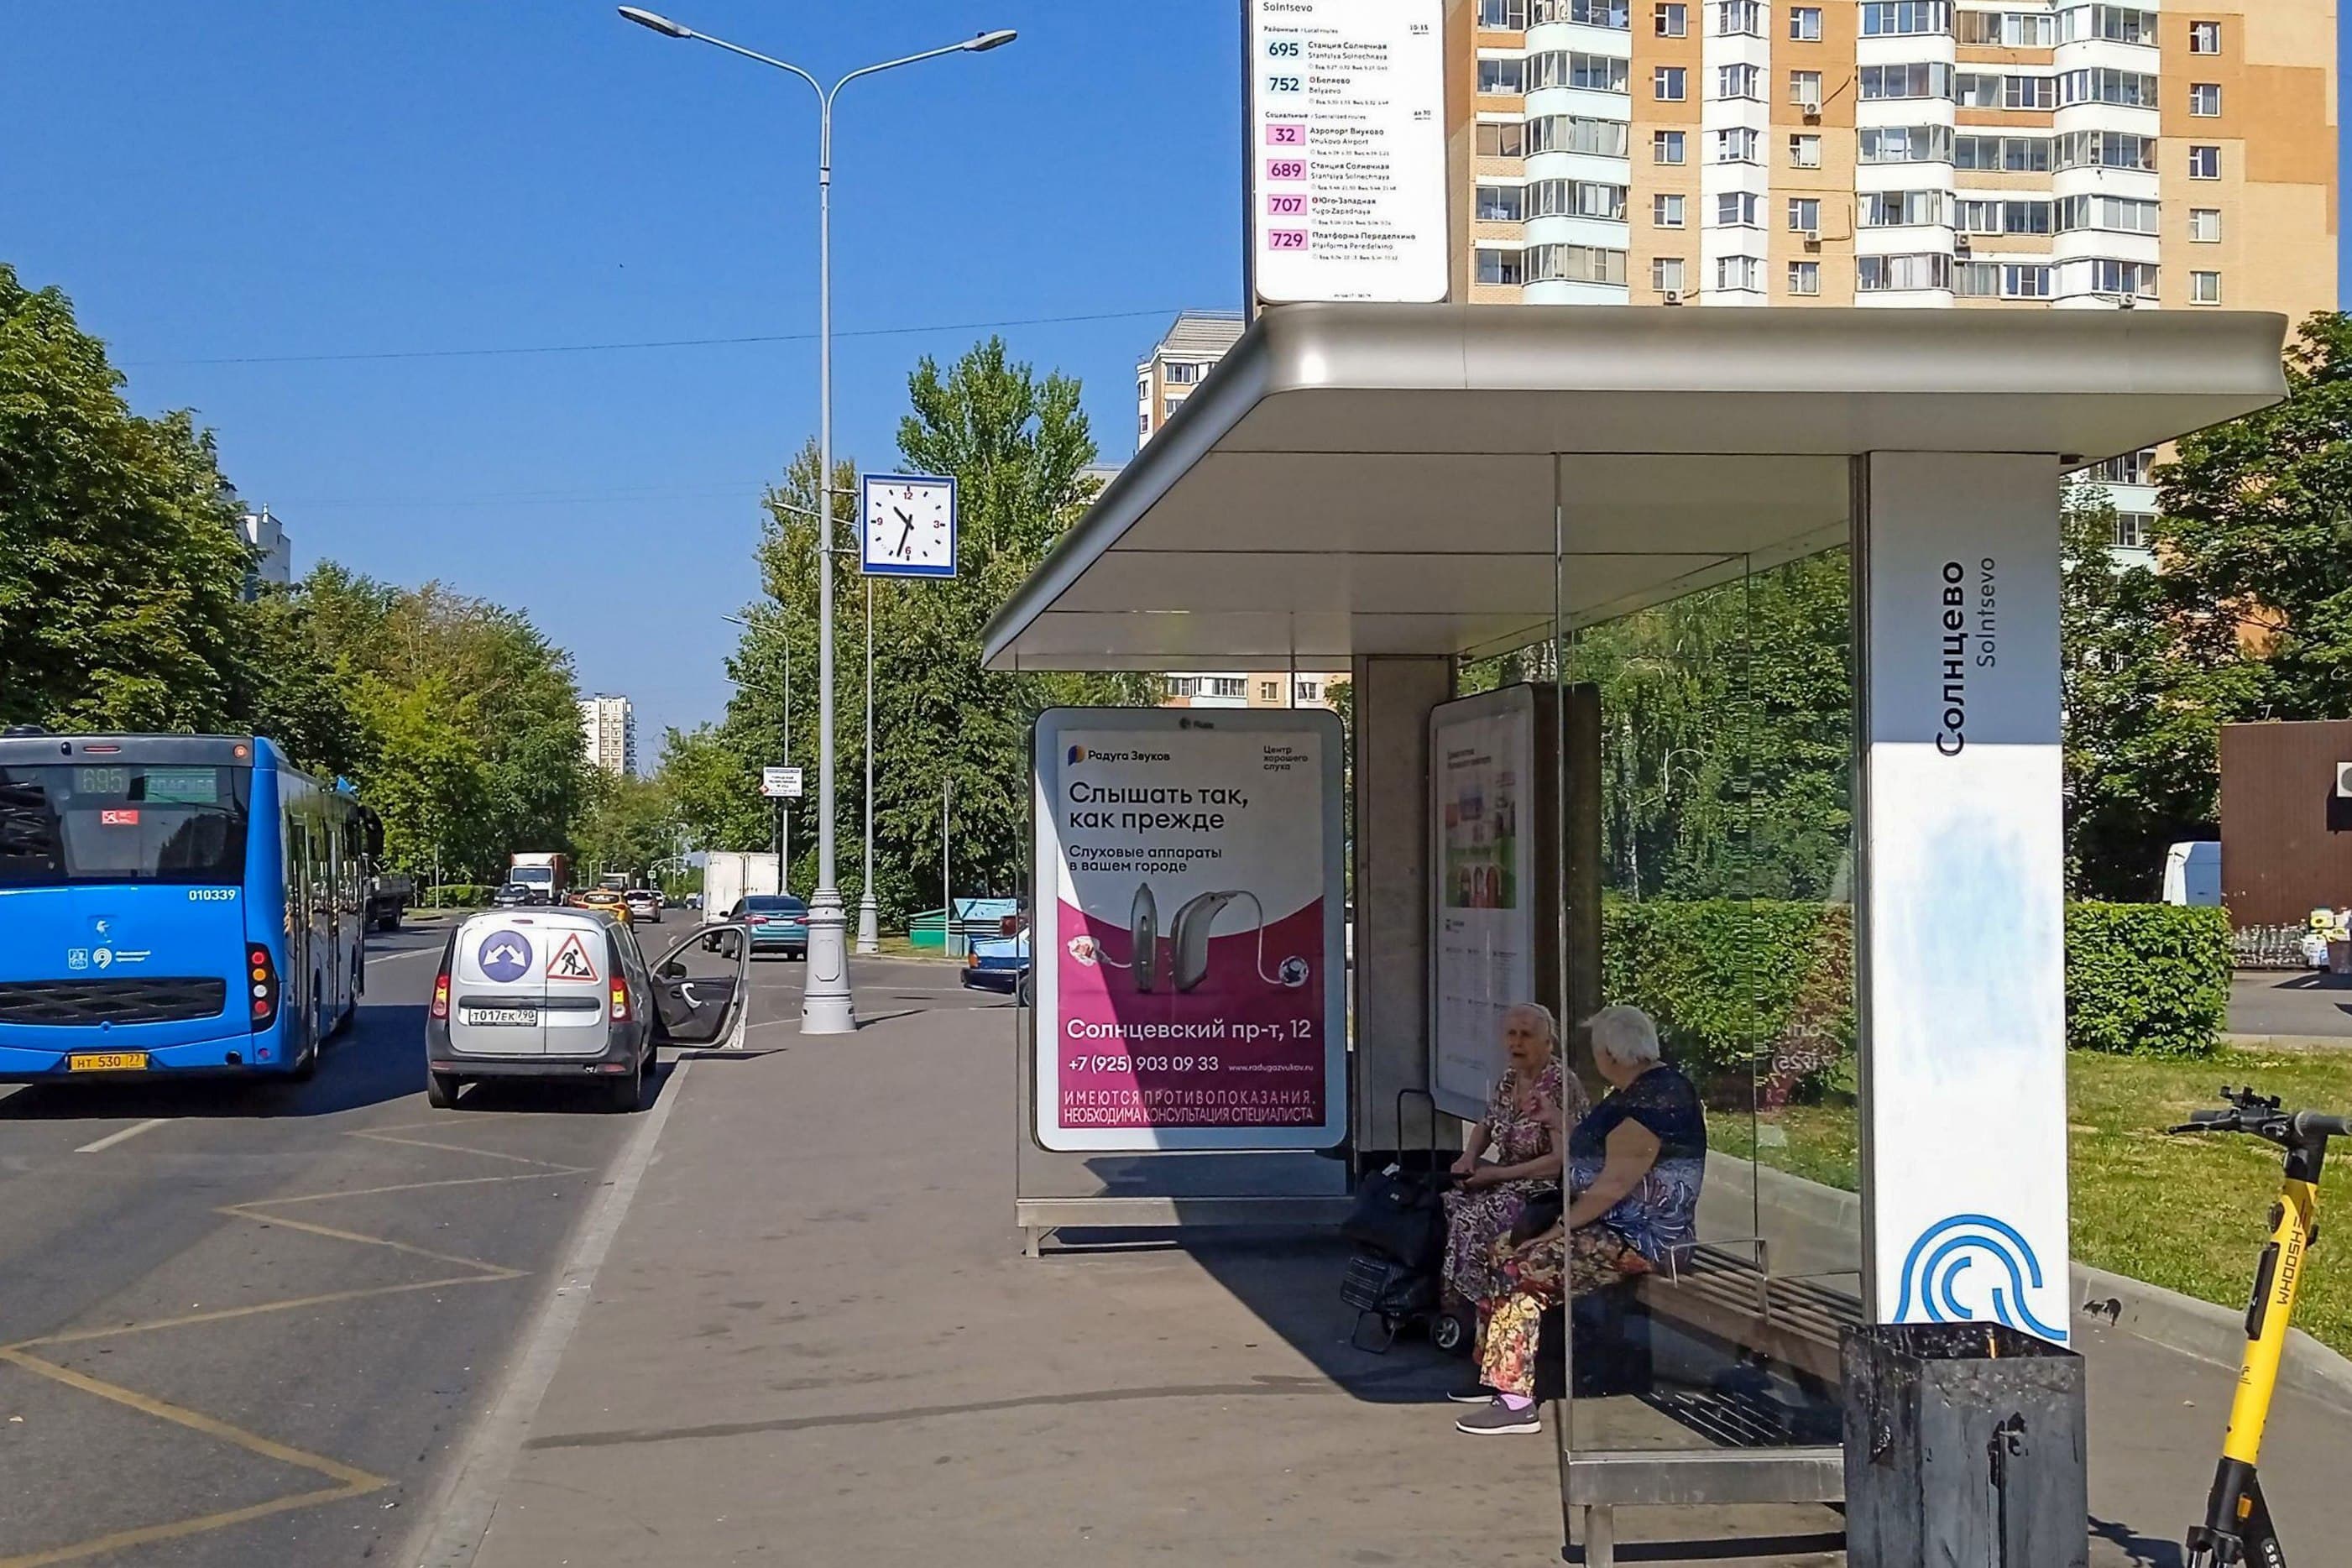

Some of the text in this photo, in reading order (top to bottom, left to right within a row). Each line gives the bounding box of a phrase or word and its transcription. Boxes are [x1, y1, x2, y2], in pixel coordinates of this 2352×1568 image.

[1262, 2, 1313, 13] Solntsevo
[1269, 42, 1299, 56] 695
[1308, 41, 1341, 50] Станция
[1269, 77, 1300, 91] 752
[1275, 128, 1295, 142] 32
[1309, 128, 1384, 136] Аэропорт Внуково
[1271, 163, 1301, 177] 689
[1272, 198, 1302, 212] 707
[1319, 196, 1376, 205] Юго-Западная
[1273, 233, 1303, 247] 729
[903, 492, 913, 500] 12
[876, 517, 883, 525] 9
[933, 520, 940, 529] 3
[905, 546, 912, 555] 6
[1975, 557, 1995, 667] Solntsevo
[1936, 562, 1968, 756] Солнцево
[1088, 750, 1170, 763] Радуга Звуков
[1263, 745, 1293, 755] Центр
[83, 768, 123, 793] 695
[1069, 781, 1249, 808] Слышать так,
[1069, 812, 1225, 834] как прежде
[1069, 845, 1221, 860] Слуховые аппараты
[1069, 862, 1187, 874] в вашем городе
[188, 890, 236, 901] 010339
[1066, 1018, 1312, 1043] Солнцевский пр-т, 12
[98, 1056, 122, 1068] 530
[128, 1054, 140, 1063] 77
[1069, 1055, 1219, 1074] +7 (925) 903 09 33
[1228, 1064, 1314, 1073] www.radugazvukov.ru
[1064, 1090, 1316, 1105] ИМЕЮТСЯ ПРОТИВОПОКАЗАНИЯ.
[1064, 1107, 1315, 1125] НЕОБХОДИМА КОНСУЛЬТАЦИЯ СПЕЦИАЛИСТА
[2276, 1230, 2303, 1305] WHOOSH
